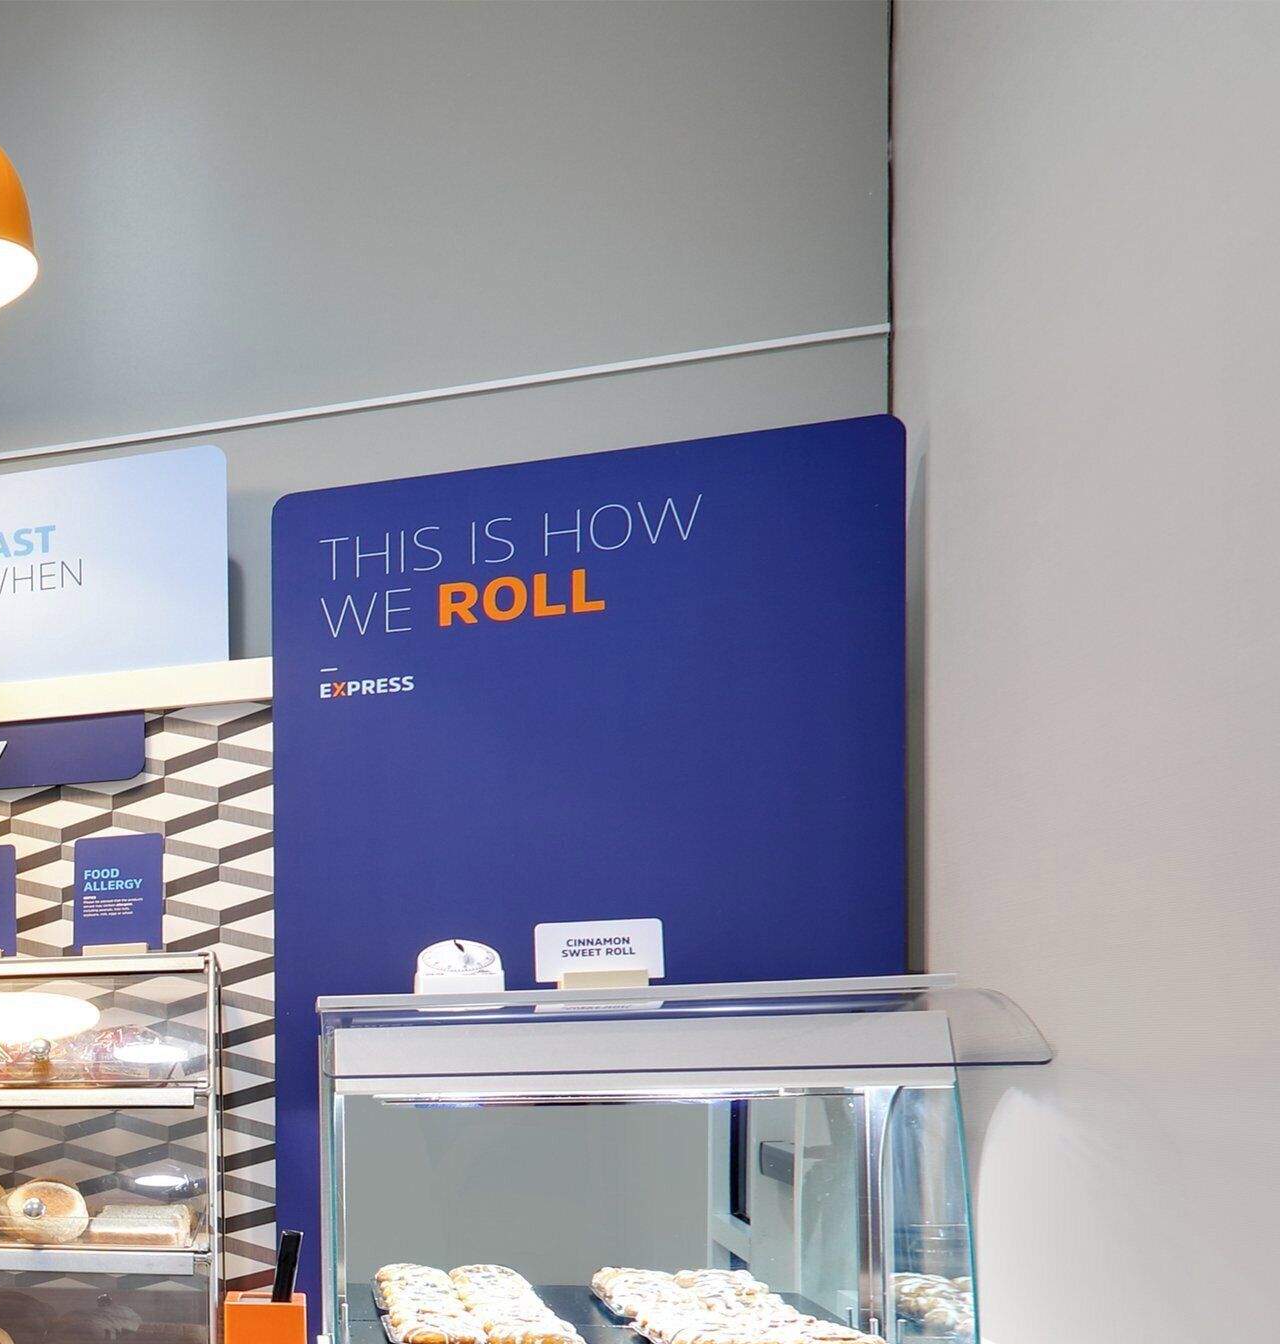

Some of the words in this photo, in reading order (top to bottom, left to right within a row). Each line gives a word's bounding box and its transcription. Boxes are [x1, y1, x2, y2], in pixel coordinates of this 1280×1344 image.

[319, 526, 443, 581] THIS
[471, 517, 515, 565] IS
[544, 493, 702, 557] HOW
[320, 587, 412, 638] WE
[439, 568, 606, 627] ROLL
[319, 675, 414, 699] EXPRESS
[84, 868, 120, 880] FOOD
[83, 879, 143, 892] ALLERGY
[566, 936, 630, 947] CINNAMON
[561, 948, 602, 958] SWEET
[606, 947, 636, 956] ROLL
